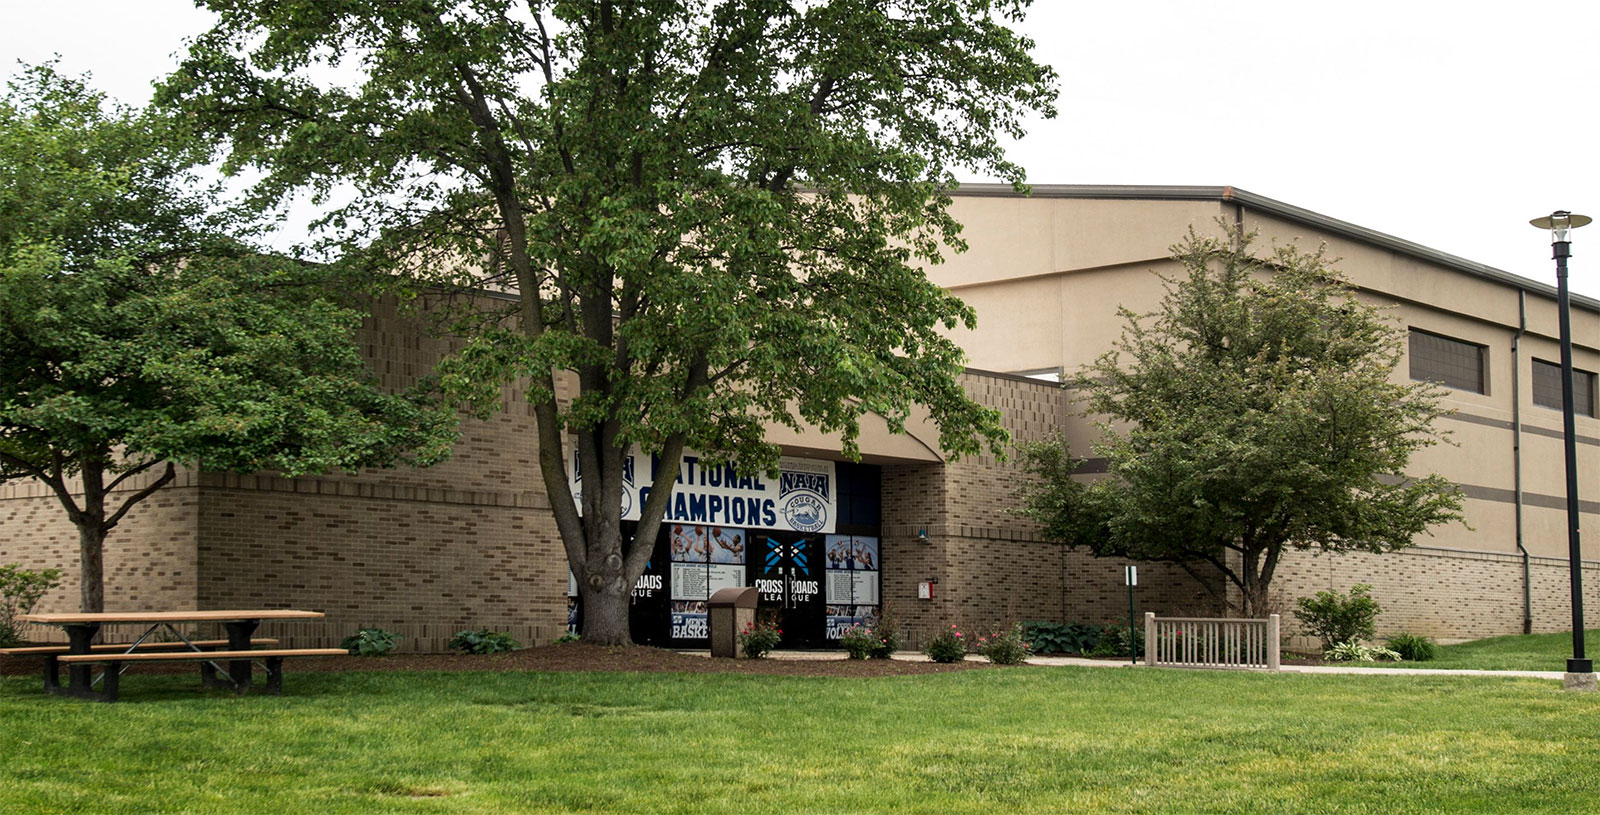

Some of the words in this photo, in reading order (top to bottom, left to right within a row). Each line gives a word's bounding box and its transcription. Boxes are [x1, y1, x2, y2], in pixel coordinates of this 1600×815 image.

[651, 452, 766, 491] TIONAL
[779, 470, 830, 504] NAIA
[639, 486, 777, 527] CAMPIONS
[790, 496, 822, 511] COUGAR
[634, 574, 663, 590] OADS
[755, 579, 783, 594] CROSS
